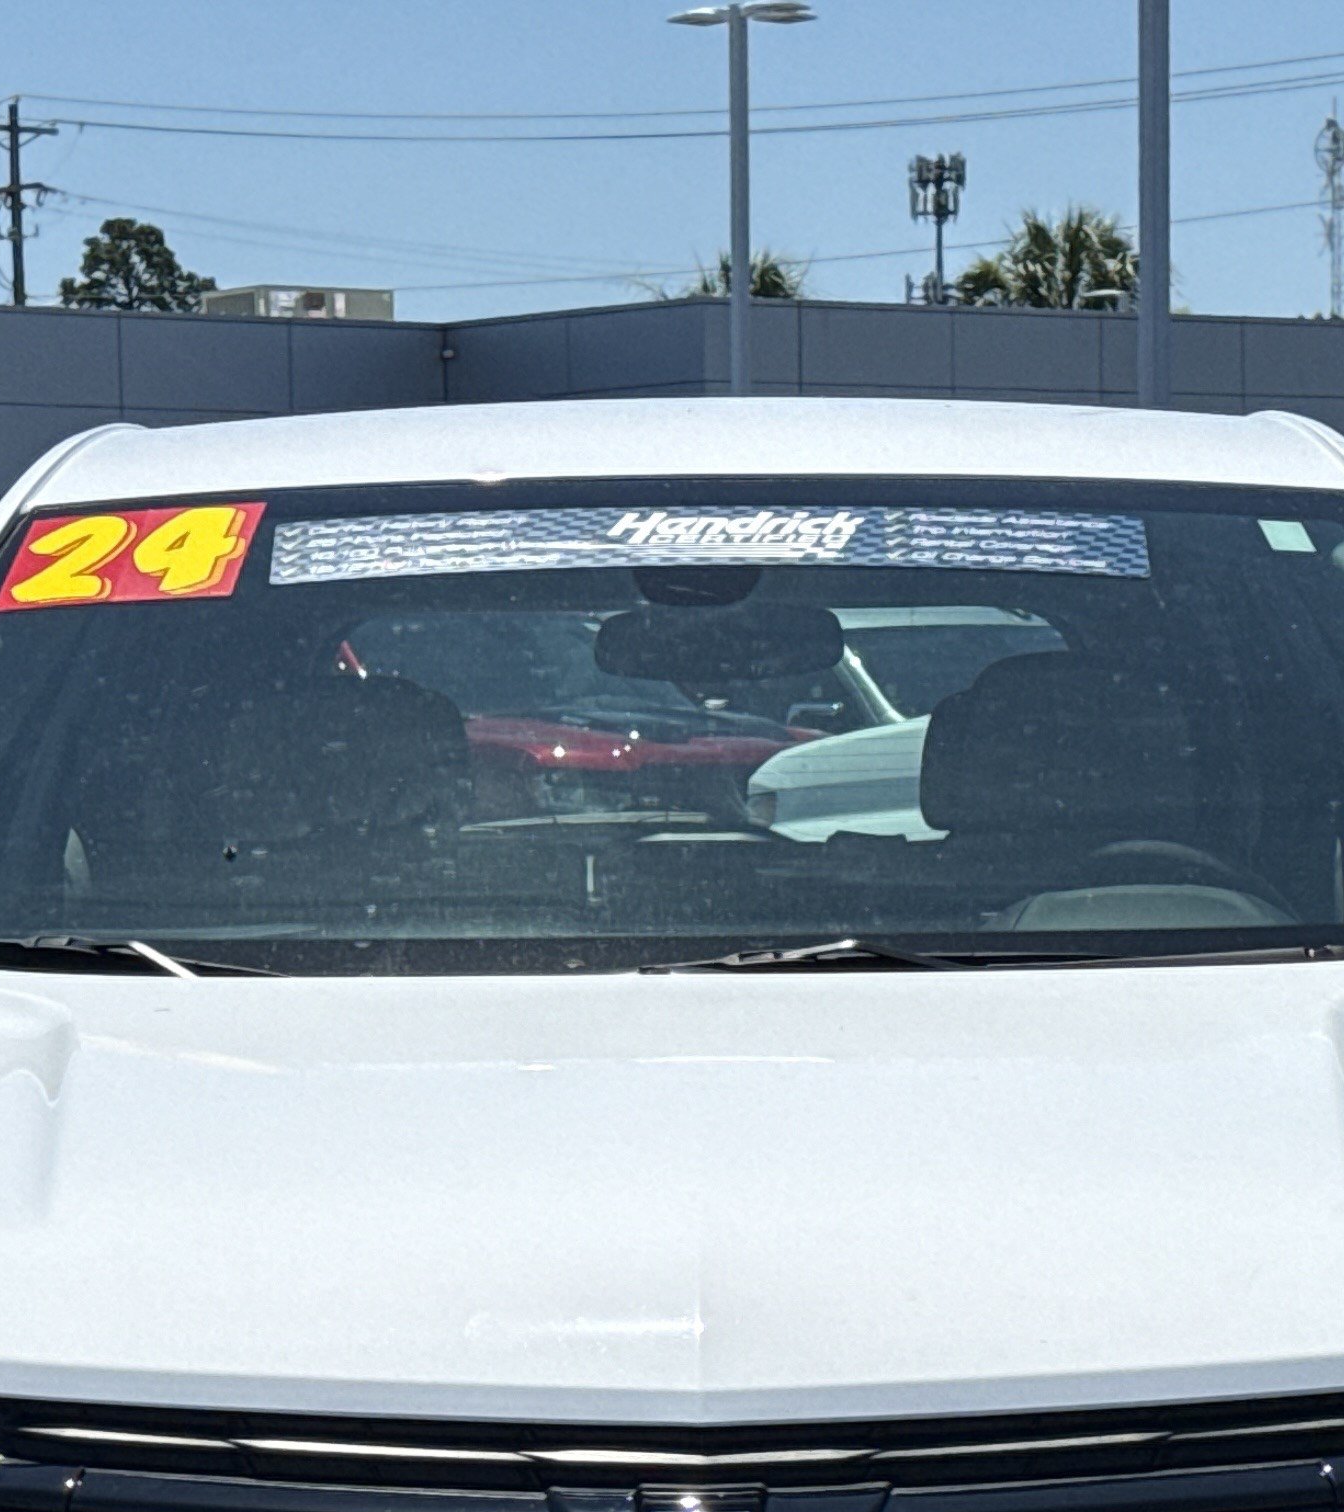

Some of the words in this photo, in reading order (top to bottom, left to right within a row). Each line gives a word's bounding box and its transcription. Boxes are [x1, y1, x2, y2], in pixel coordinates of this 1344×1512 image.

[606, 511, 865, 544] Hendrick
[648, 534, 852, 547] CERTIFIED
[10, 506, 247, 605] 24
